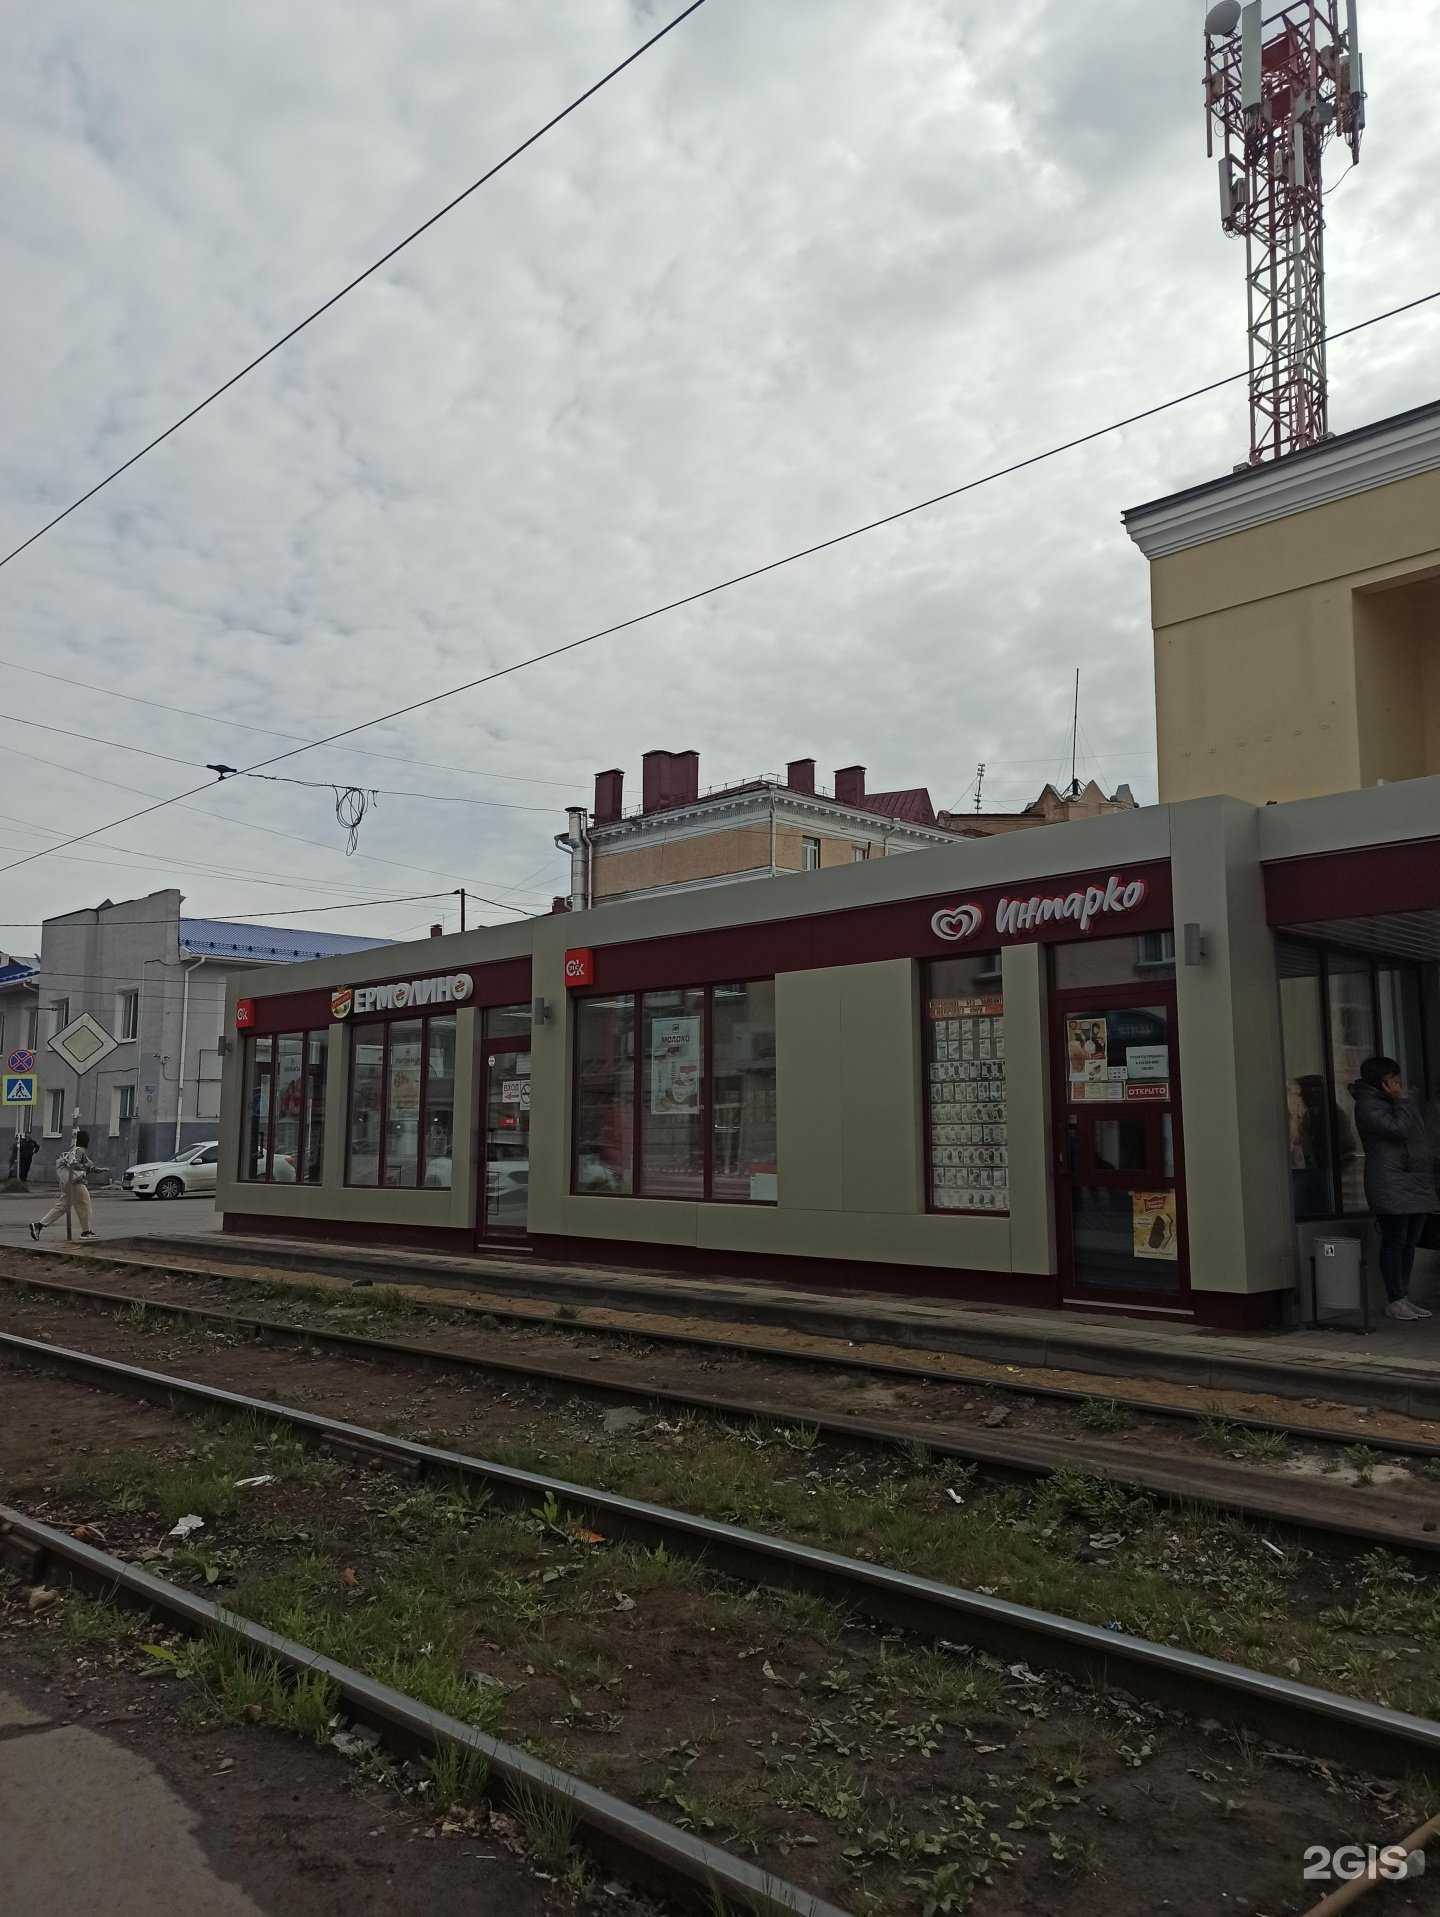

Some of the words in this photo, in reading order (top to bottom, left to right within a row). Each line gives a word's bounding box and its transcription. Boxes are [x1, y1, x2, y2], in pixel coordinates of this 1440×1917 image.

[995, 876, 1145, 934] Инмарко
[354, 973, 474, 1013] ЕРМОЛИНО
[1128, 1087, 1166, 1096] ОТКРЫТО
